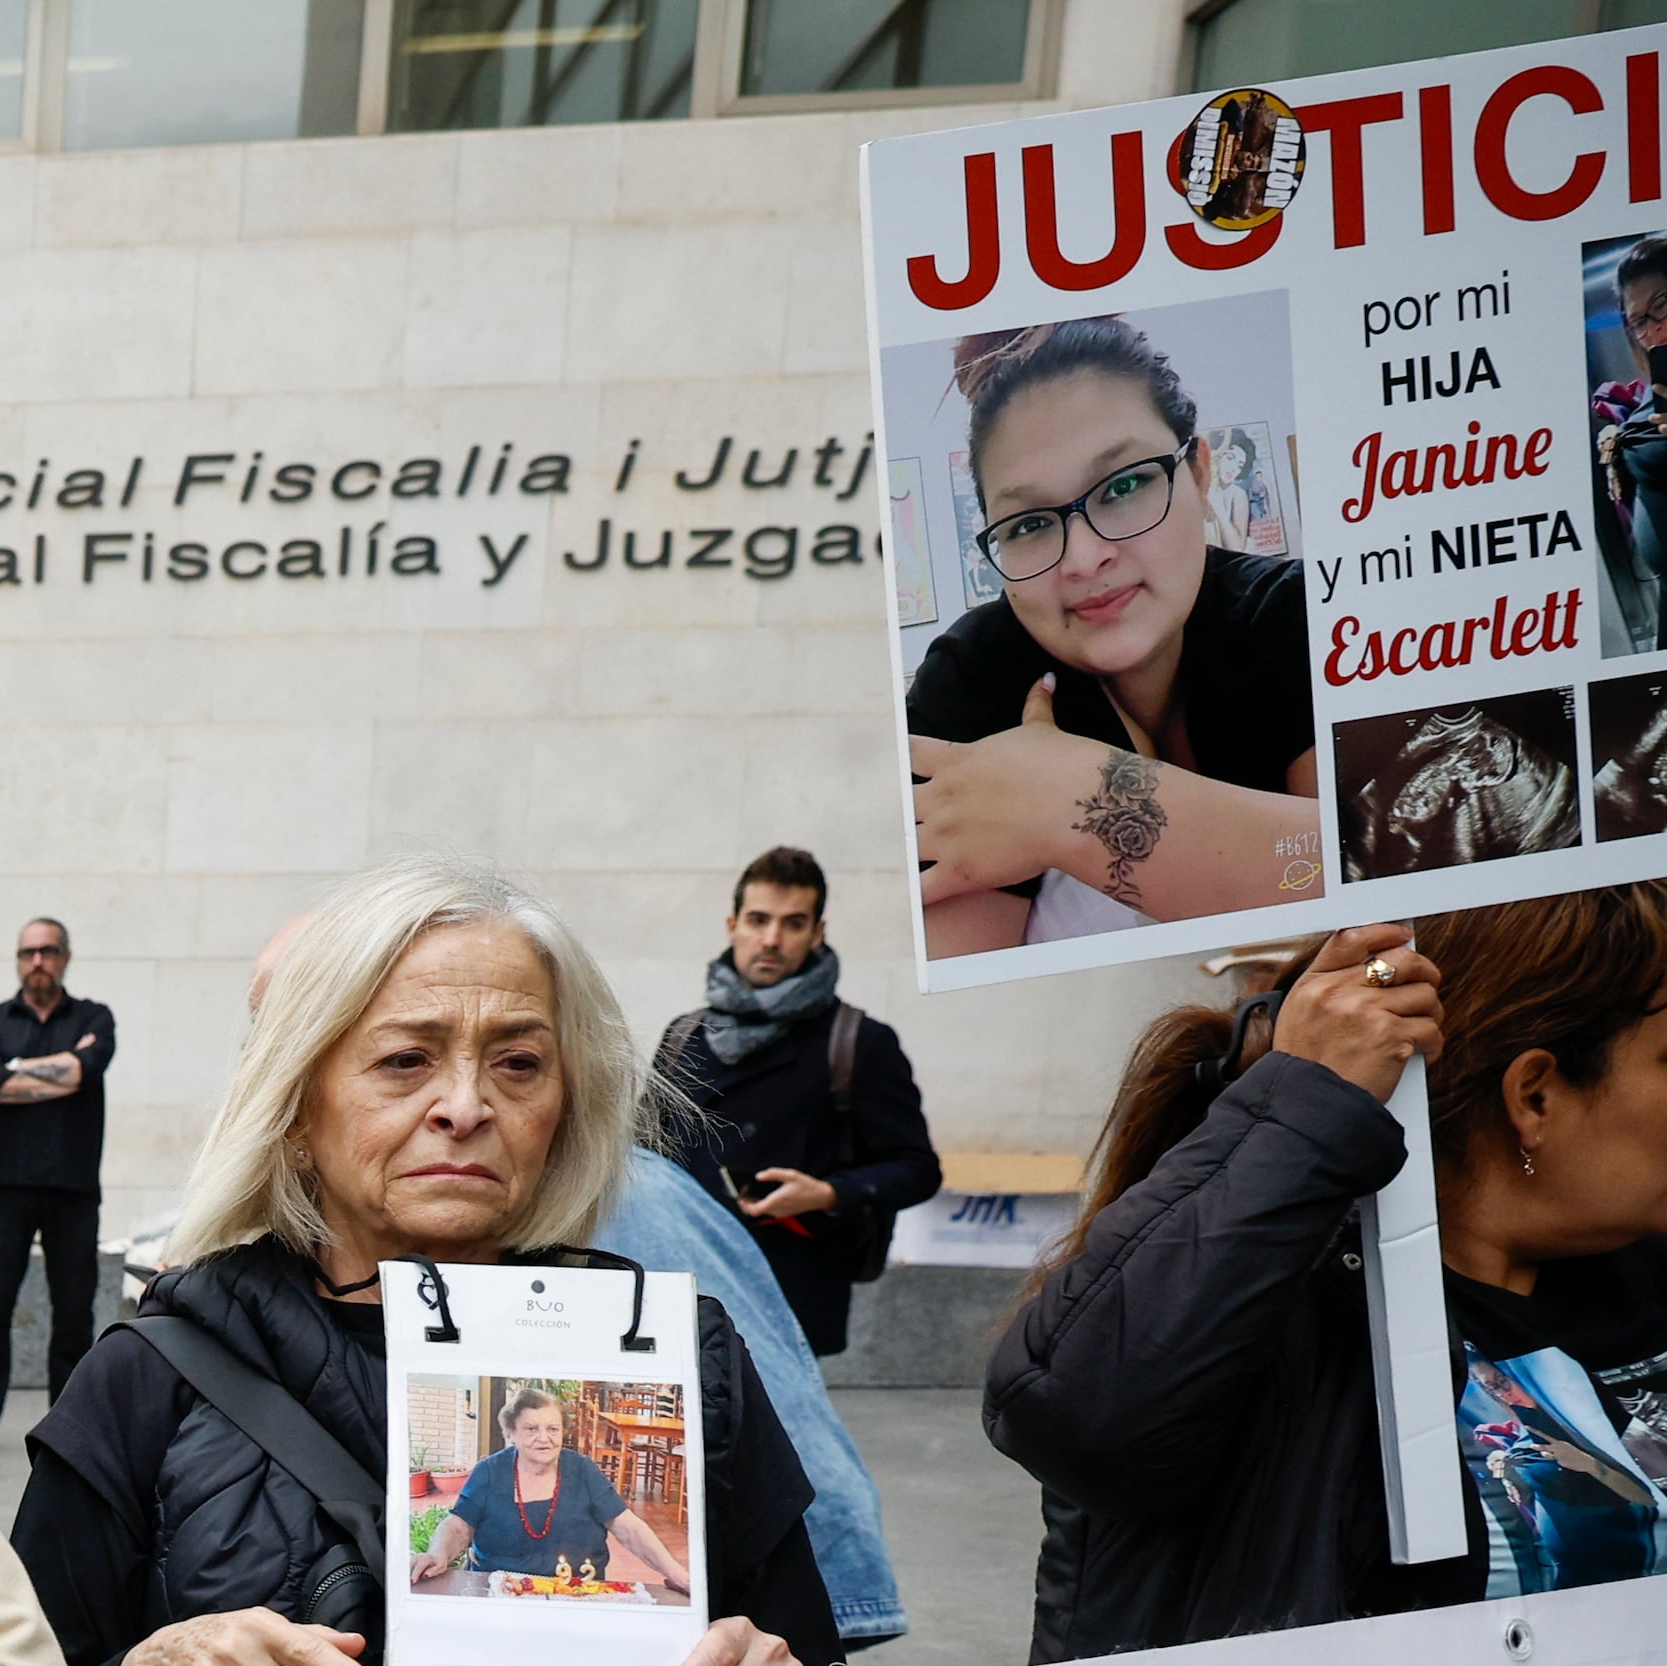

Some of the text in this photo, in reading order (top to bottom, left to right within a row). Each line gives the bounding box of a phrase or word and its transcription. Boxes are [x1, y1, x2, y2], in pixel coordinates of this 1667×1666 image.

[1263, 116, 1302, 210] MAZÓN
[1363, 269, 1512, 348] por mi
[1381, 346, 1501, 406] HIJA
[172, 443, 572, 507] Fiscalia
[614, 438, 642, 493] i
[1341, 420, 1553, 524] Janine
[82, 520, 442, 584] Fiscalía
[478, 532, 529, 587] y
[563, 518, 883, 580] Juzga
[1316, 509, 1583, 604] y mi NIETA
[1323, 587, 1584, 687] Escarlett
